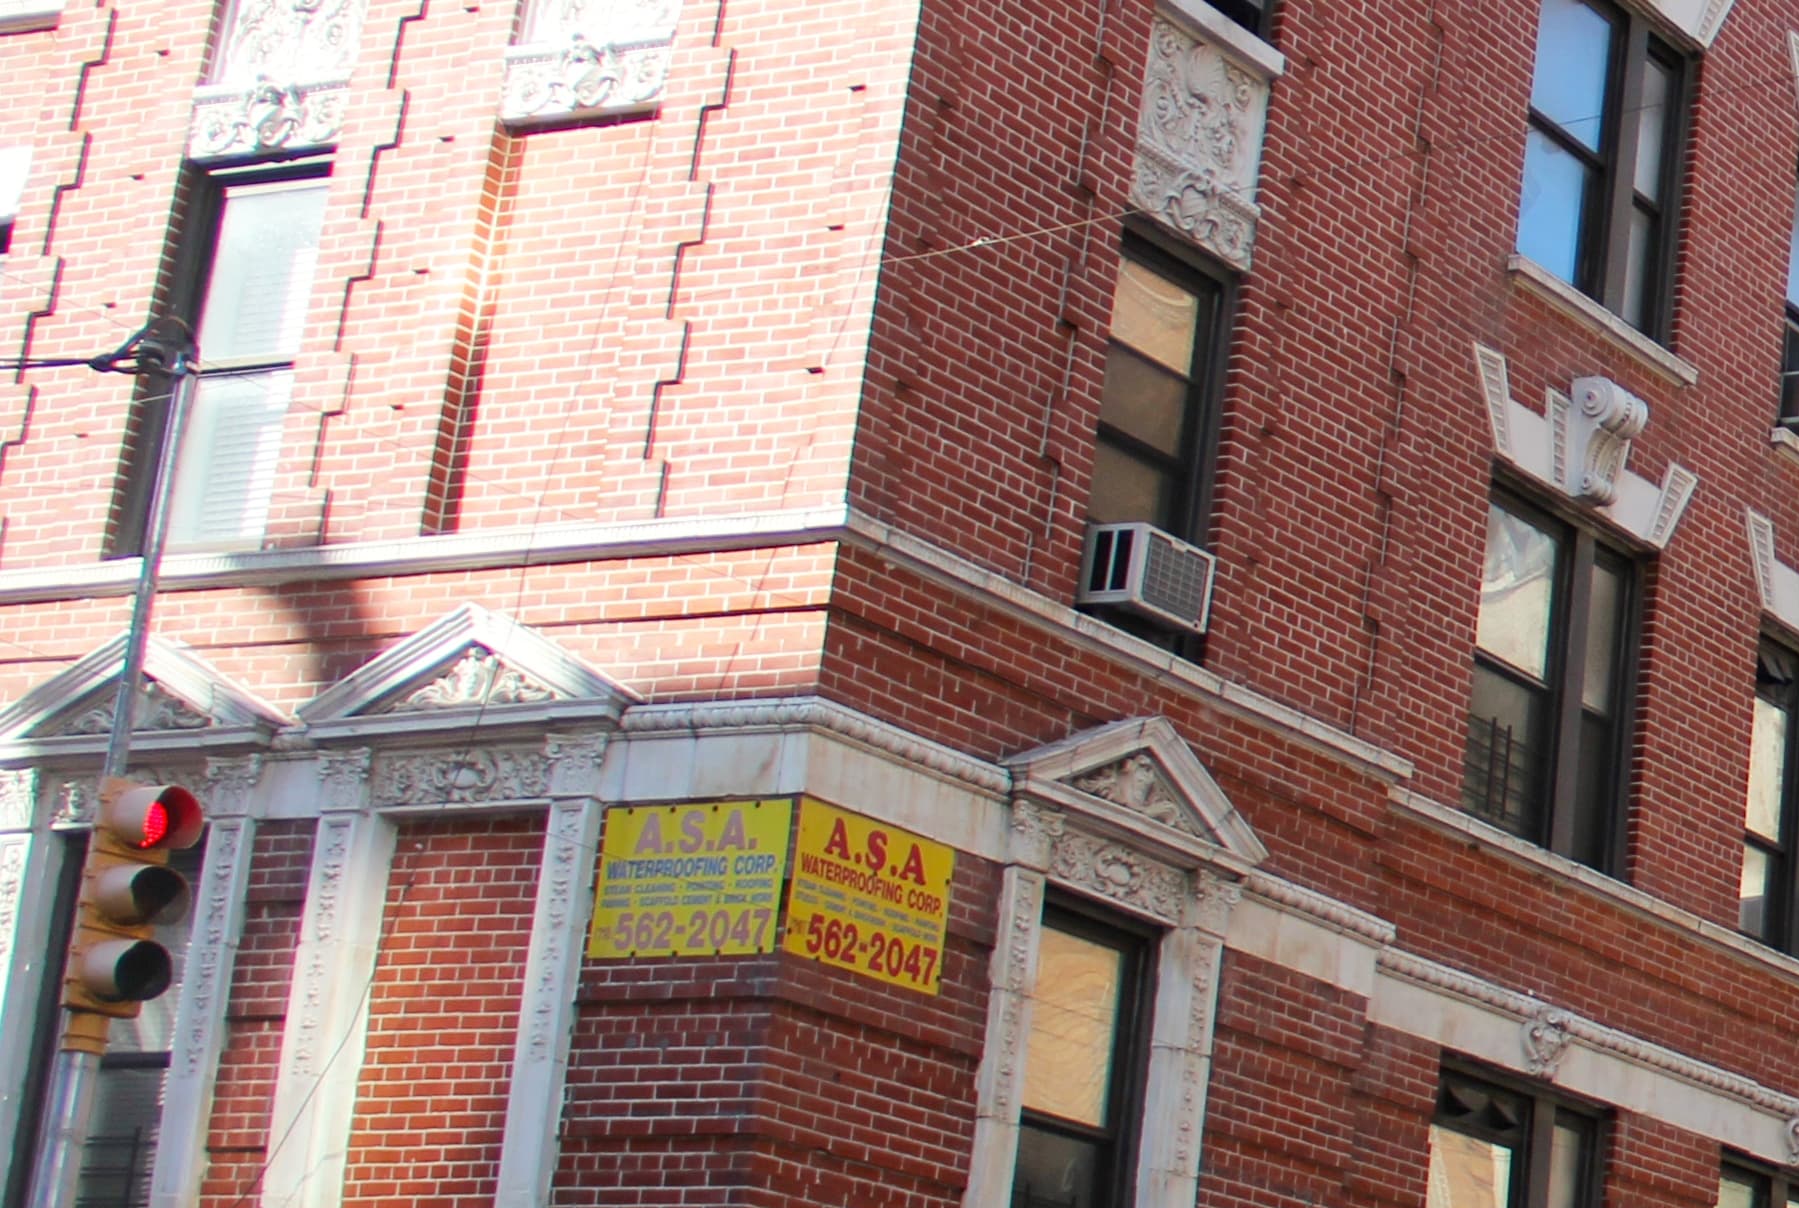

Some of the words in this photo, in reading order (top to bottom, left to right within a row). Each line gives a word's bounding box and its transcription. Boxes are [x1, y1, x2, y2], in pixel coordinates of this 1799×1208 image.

[634, 809, 758, 854] A.S.A.
[824, 817, 926, 886] A.S.A
[606, 857, 728, 880] WATERPROOFING
[734, 854, 778, 875] CORP.
[801, 852, 903, 904] WATERPROOFING
[907, 888, 943, 918] CORP.
[614, 908, 772, 950] 562-2047
[805, 913, 938, 986] 562-2047
